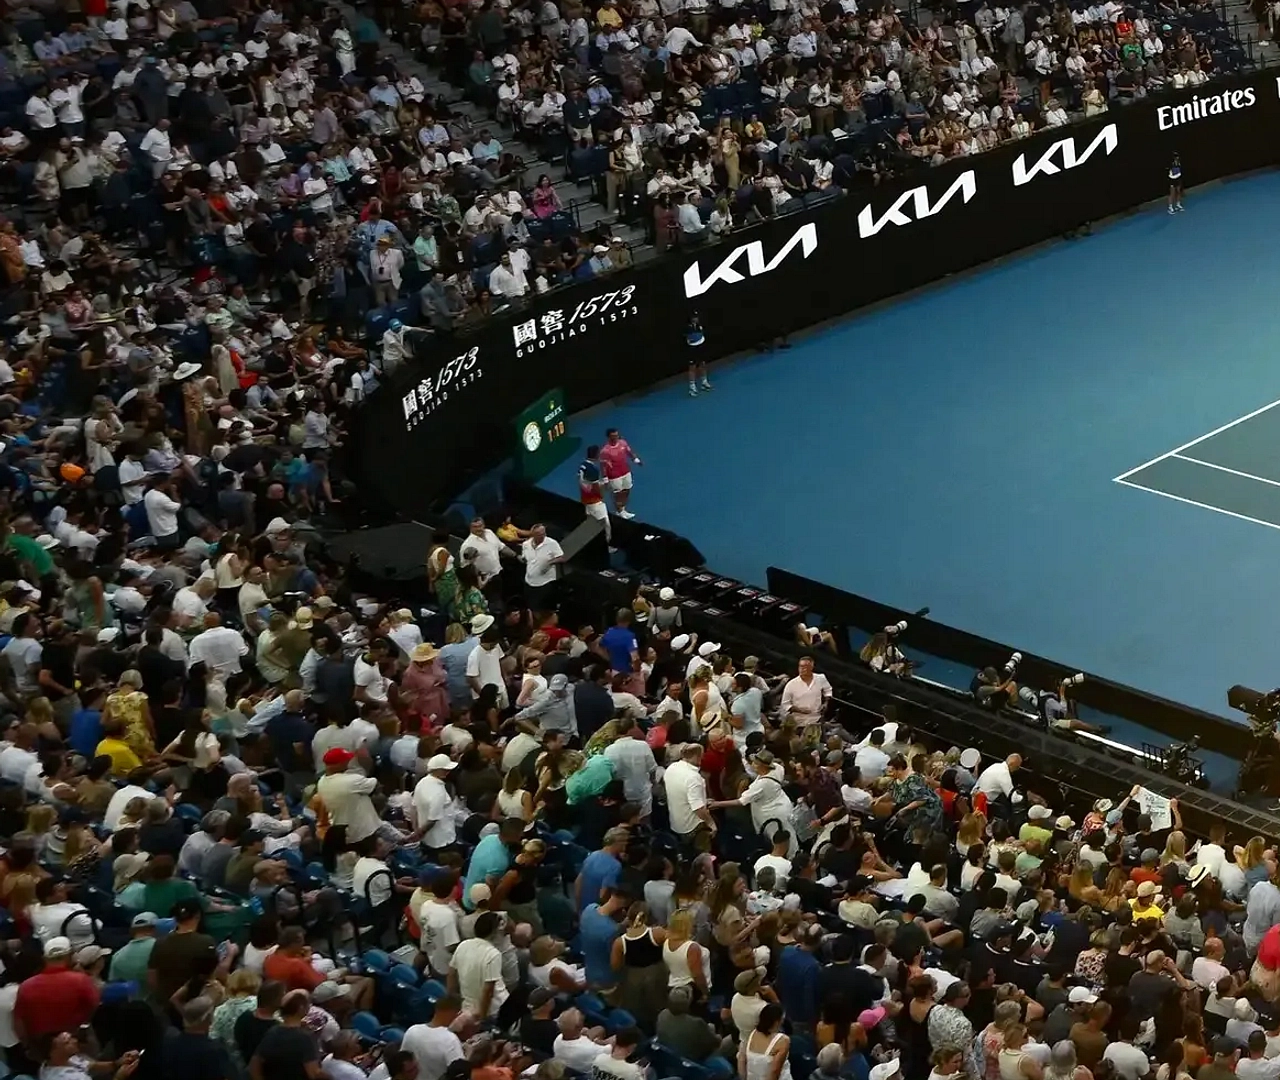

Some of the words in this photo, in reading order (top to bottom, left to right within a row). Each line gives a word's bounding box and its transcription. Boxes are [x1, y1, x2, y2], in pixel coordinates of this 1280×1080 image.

[1156, 85, 1257, 132] Emirates
[516, 324, 588, 359] GUOJIAO
[600, 306, 639, 326] 1573
[406, 393, 448, 432] GUOJIAO
[455, 369, 483, 392] 1573
